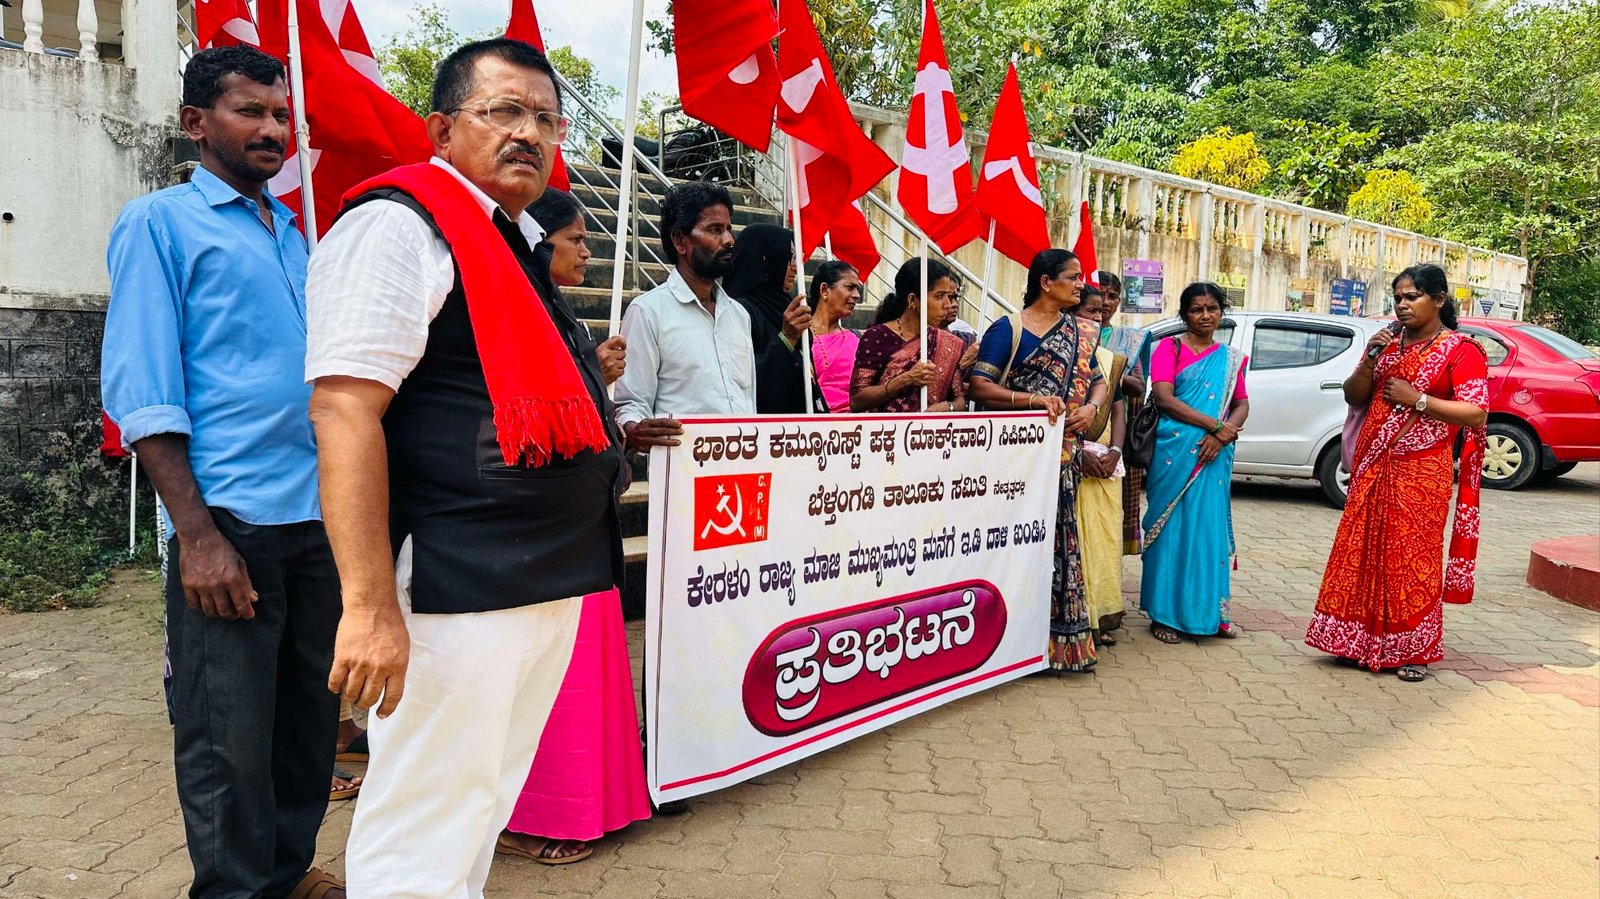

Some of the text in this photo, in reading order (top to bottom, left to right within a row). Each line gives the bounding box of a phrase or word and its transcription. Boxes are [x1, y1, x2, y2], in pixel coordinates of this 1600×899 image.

[693, 426, 759, 467] ಭಾರತ
[769, 424, 863, 472] ಕಮ್ಯೂನಿಸ್ಟ್
[870, 422, 896, 465] ಪಕ್ಷ
[999, 423, 1045, 446] ಸಿಪಿಐಎಂ
[808, 481, 875, 526] ಬೆಳ್ತಂಗಡಿ
[883, 474, 945, 508] ತಾಲೂಕು
[951, 473, 988, 500] ಸಮಿತಿ
[687, 559, 751, 608] ಕೇರಳಂ
[759, 560, 796, 606] ರಾಜ್ಯ
[803, 547, 841, 584] ಮಾಜಿ
[848, 534, 917, 588] ಮುಖ್ಯಮಂತ್ರಿ
[922, 525, 956, 562] ಮನೆಗೆ
[986, 525, 1009, 551] ದಾಳಿ
[1013, 518, 1047, 546] ಖಂಡಿಸಿ
[774, 589, 976, 721] ಪ್ರತಿಭಟನೆ
